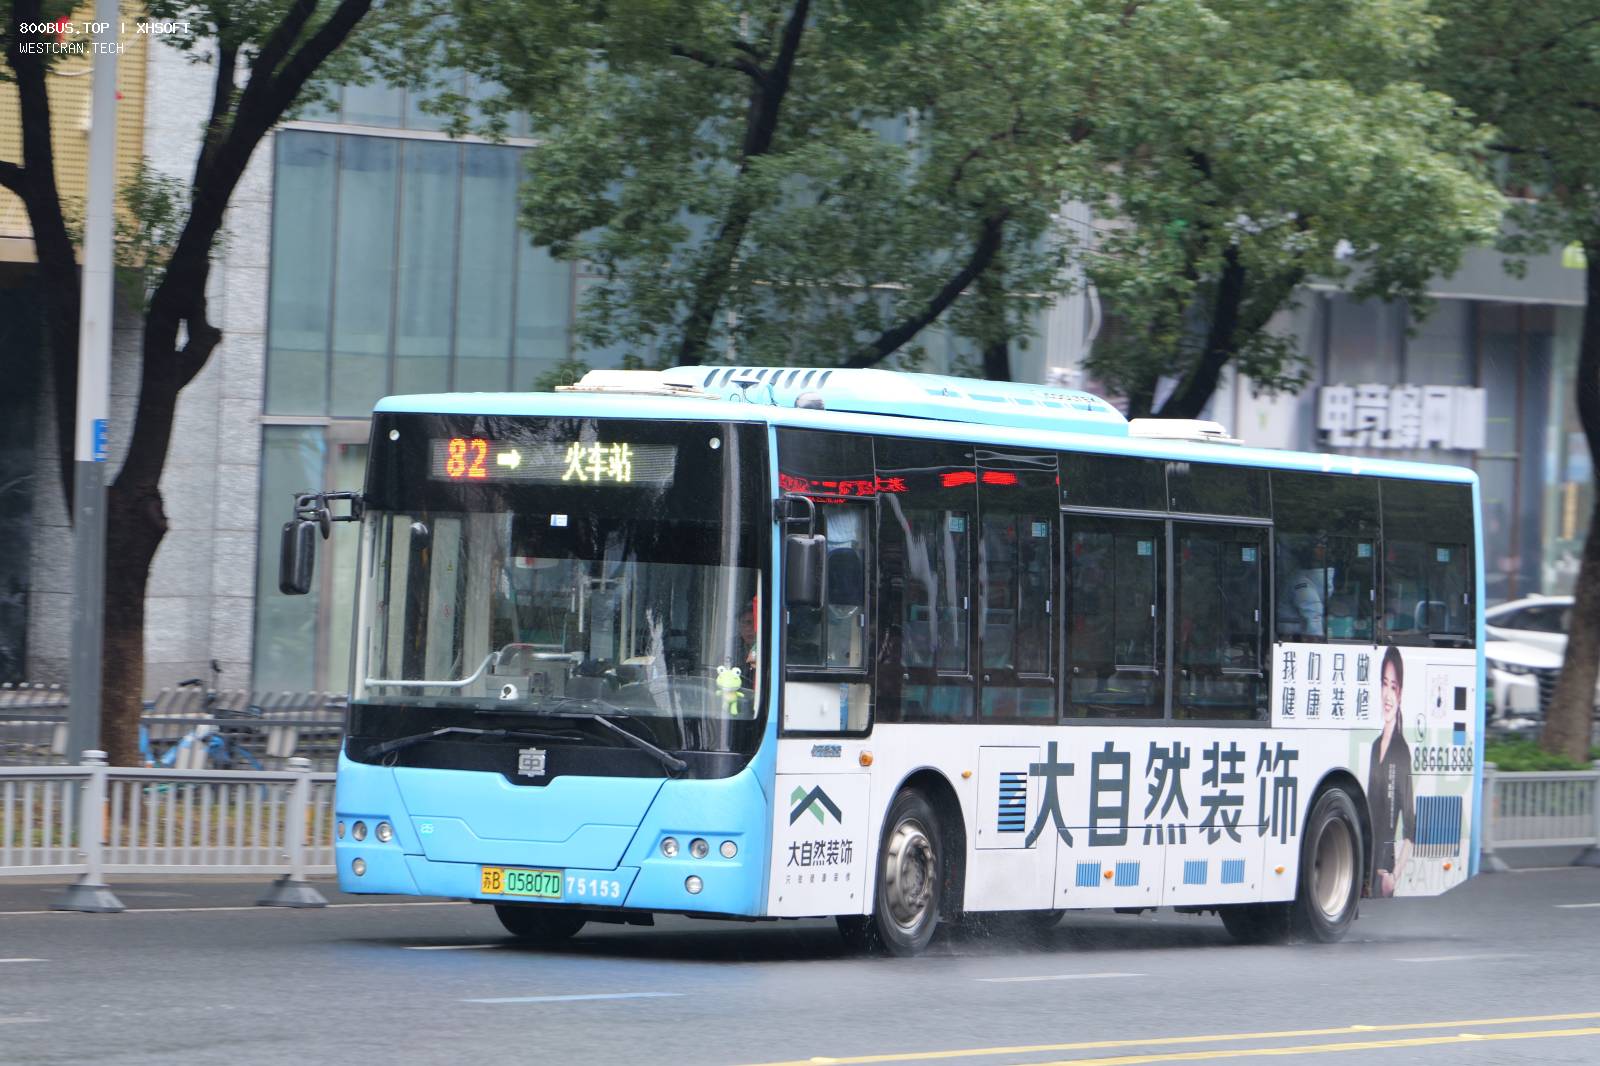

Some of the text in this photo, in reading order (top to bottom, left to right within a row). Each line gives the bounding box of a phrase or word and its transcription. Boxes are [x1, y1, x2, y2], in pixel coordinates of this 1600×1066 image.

[446, 438, 487, 478] 82
[562, 442, 633, 482] 火车站
[1282, 650, 1370, 683] 我们只做
[1281, 686, 1370, 718] 健康装修
[1413, 747, 1473, 771] 88661888
[1025, 741, 1299, 848] 大自然装饰
[786, 839, 854, 867] 大自然装饰
[566, 876, 621, 898] 75153
